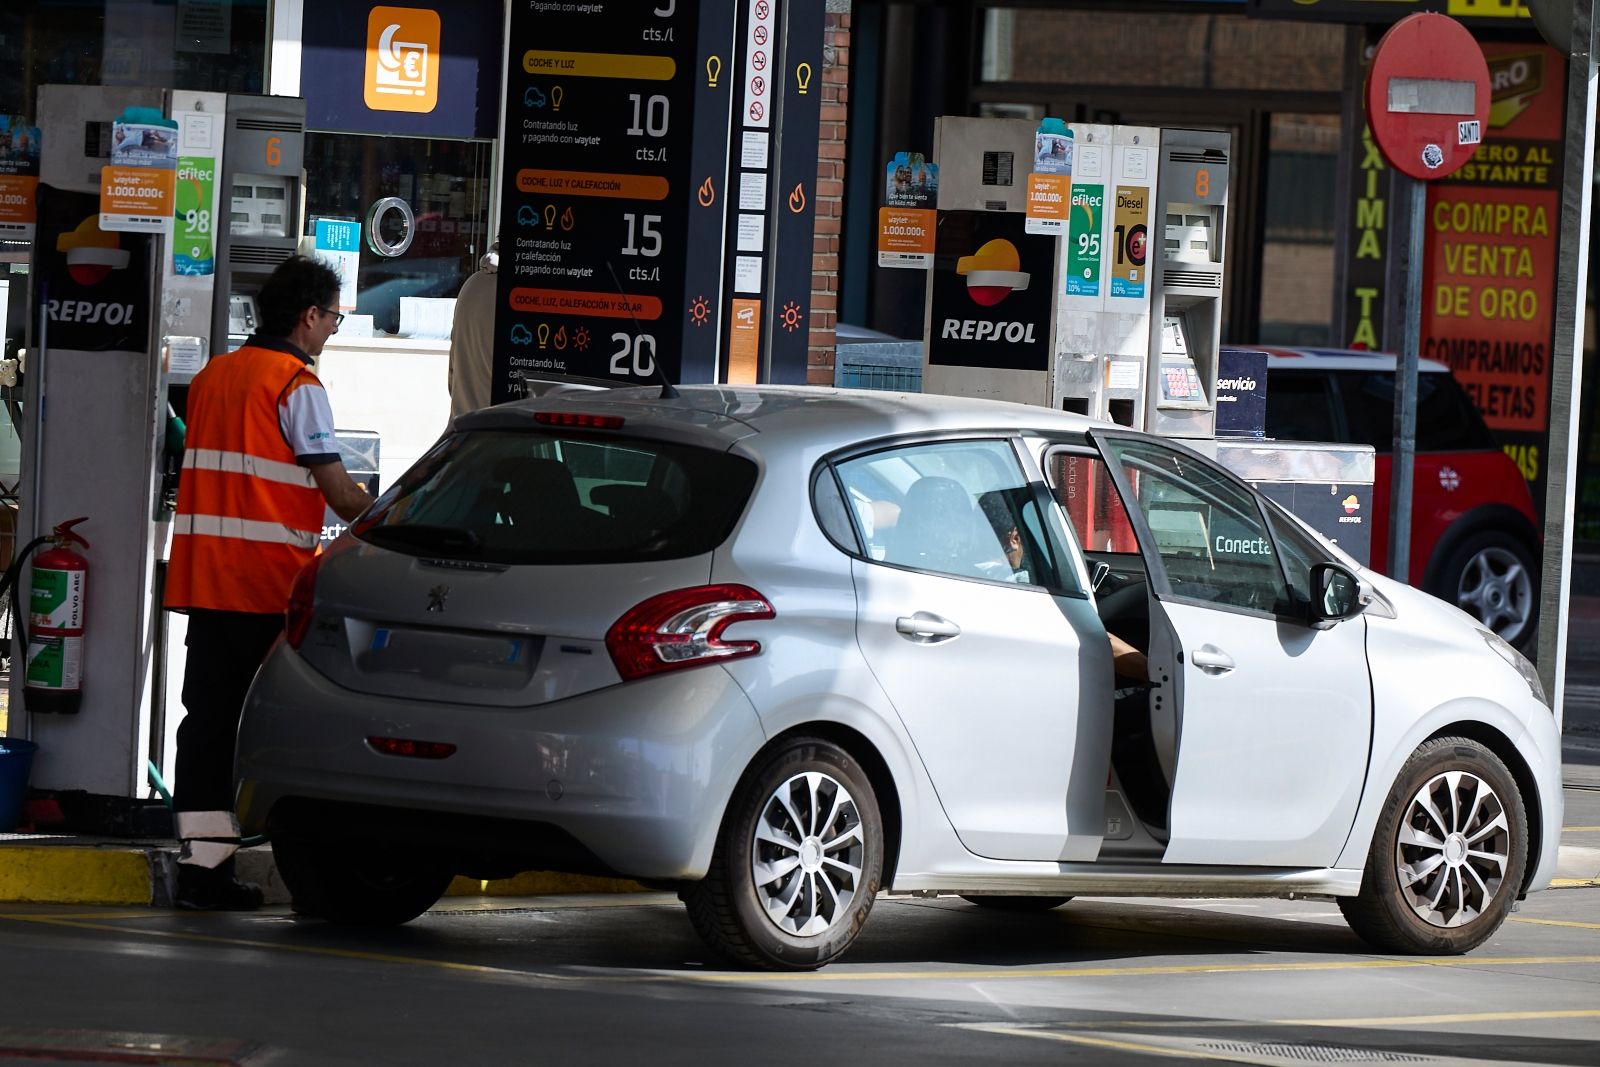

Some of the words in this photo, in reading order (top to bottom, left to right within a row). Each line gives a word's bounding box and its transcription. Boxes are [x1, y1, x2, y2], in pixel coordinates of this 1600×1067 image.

[530, 1, 561, 12] Pagando
[562, 3, 575, 12] con
[642, 27, 674, 42] cts./l
[528, 58, 552, 68] COCHE
[554, 59, 560, 67] Y
[561, 59, 575, 69] LUZ
[626, 93, 670, 138] 10
[523, 119, 566, 131] Contratando
[568, 120, 579, 131] luz
[1459, 122, 1479, 142] SANTO
[528, 133, 559, 144] pagando
[560, 136, 573, 144] con
[265, 136, 281, 167] 6
[635, 147, 667, 162] cts./l
[1524, 145, 1553, 165] AL
[178, 167, 213, 181] efitec
[550, 178, 564, 188] LUZ
[565, 179, 570, 188] Y
[571, 179, 620, 191] CALEFACCIÓN
[1195, 168, 1210, 197] 8
[1356, 120, 1386, 259] XIMA
[1071, 194, 1102, 207] efitec
[1117, 196, 1143, 209] Diesel
[184, 209, 210, 234] 98
[1432, 200, 1549, 238] COMPRA
[621, 213, 663, 257] 15
[516, 237, 560, 250] Contratando
[561, 240, 571, 250] luz
[1078, 233, 1100, 256] 95
[521, 251, 561, 263] calefacción
[1443, 243, 1534, 279] VENTA
[520, 265, 551, 276] pagando
[552, 267, 565, 276] con
[629, 266, 661, 282] cts./l
[560, 297, 609, 310] CALEFACCIÓN
[617, 302, 642, 313] SOLAR
[1435, 284, 1471, 317] DE
[1479, 286, 1537, 321] ORO
[48, 298, 134, 326] REPSOL
[941, 318, 1036, 344] REPSOL
[609, 332, 656, 377] 20
[510, 356, 552, 369] Contratando
[554, 358, 566, 371] luz,
[1216, 376, 1256, 391] servicio
[72, 595, 80, 626] POLVO
